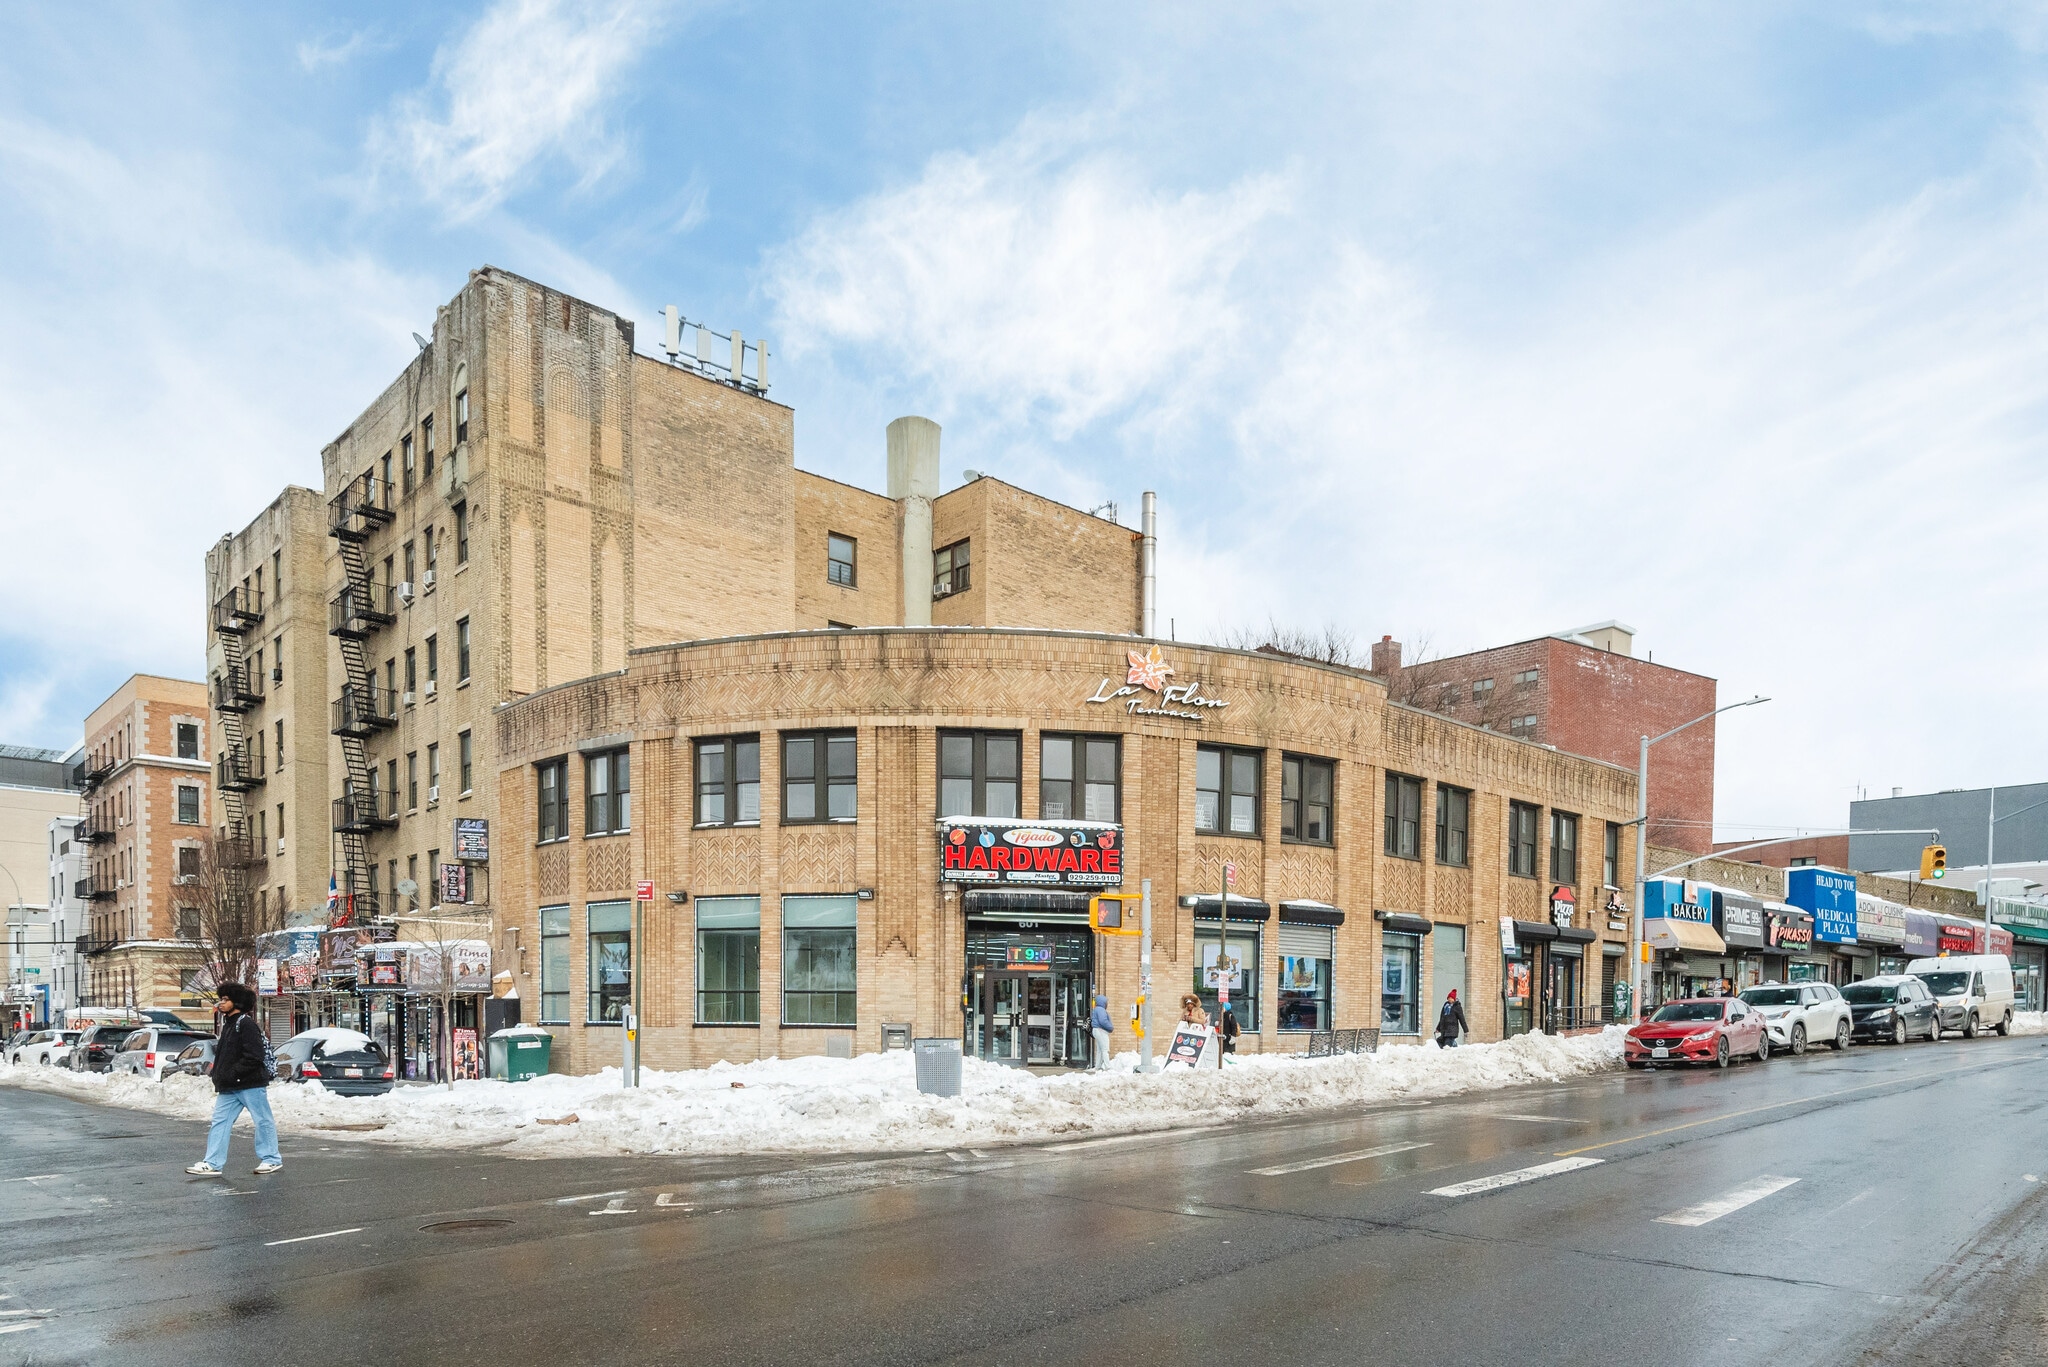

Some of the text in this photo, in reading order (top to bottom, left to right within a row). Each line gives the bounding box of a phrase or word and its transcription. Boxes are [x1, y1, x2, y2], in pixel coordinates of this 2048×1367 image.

[1086, 678, 1140, 702] La
[1126, 700, 1204, 719] Terrace
[1010, 831, 1057, 844] Tejada
[945, 845, 1120, 873] HARDWARE
[1816, 875, 1855, 891] HEAD TO TOE
[1554, 900, 1574, 916] Pizza
[1673, 903, 1708, 920] BAKERY
[1725, 906, 1750, 925] PRIME
[1816, 908, 1855, 924] MEDICAL
[1859, 902, 1904, 917] ADOM CUISINE
[1554, 913, 1570, 927] Hut
[1823, 921, 1850, 935] PLAZA
[1778, 926, 1812, 942] PIKASSO
[1906, 933, 1923, 944] metro
[1981, 935, 2007, 945] Cpital
[458, 948, 488, 958] Tima
